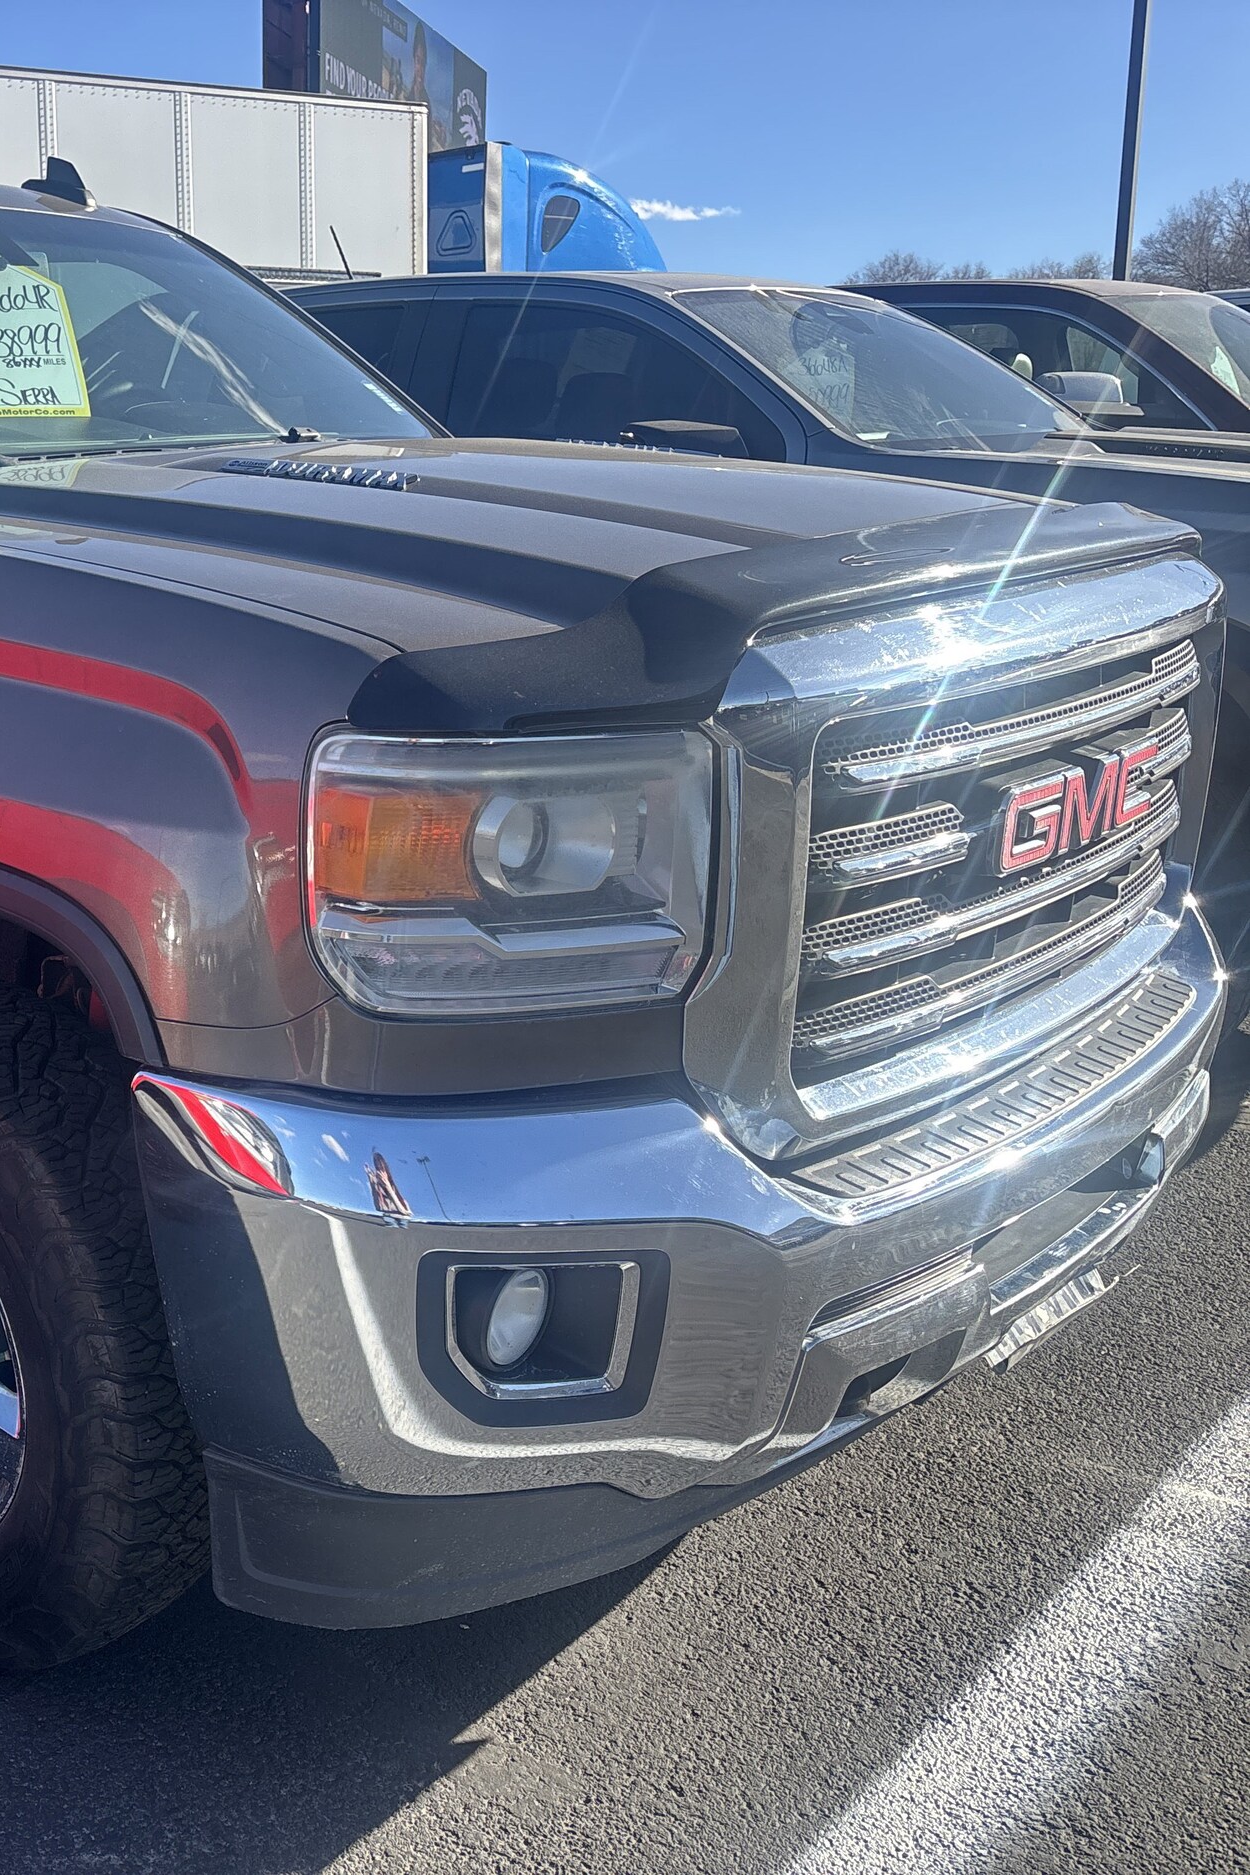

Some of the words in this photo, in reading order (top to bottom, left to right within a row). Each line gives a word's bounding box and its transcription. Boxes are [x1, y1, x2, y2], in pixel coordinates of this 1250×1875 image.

[325, 52, 346, 90] FIND
[346, 65, 367, 98] YOUR
[43, 358, 67, 366] MILES
[1000, 738, 1159, 877] GMC
